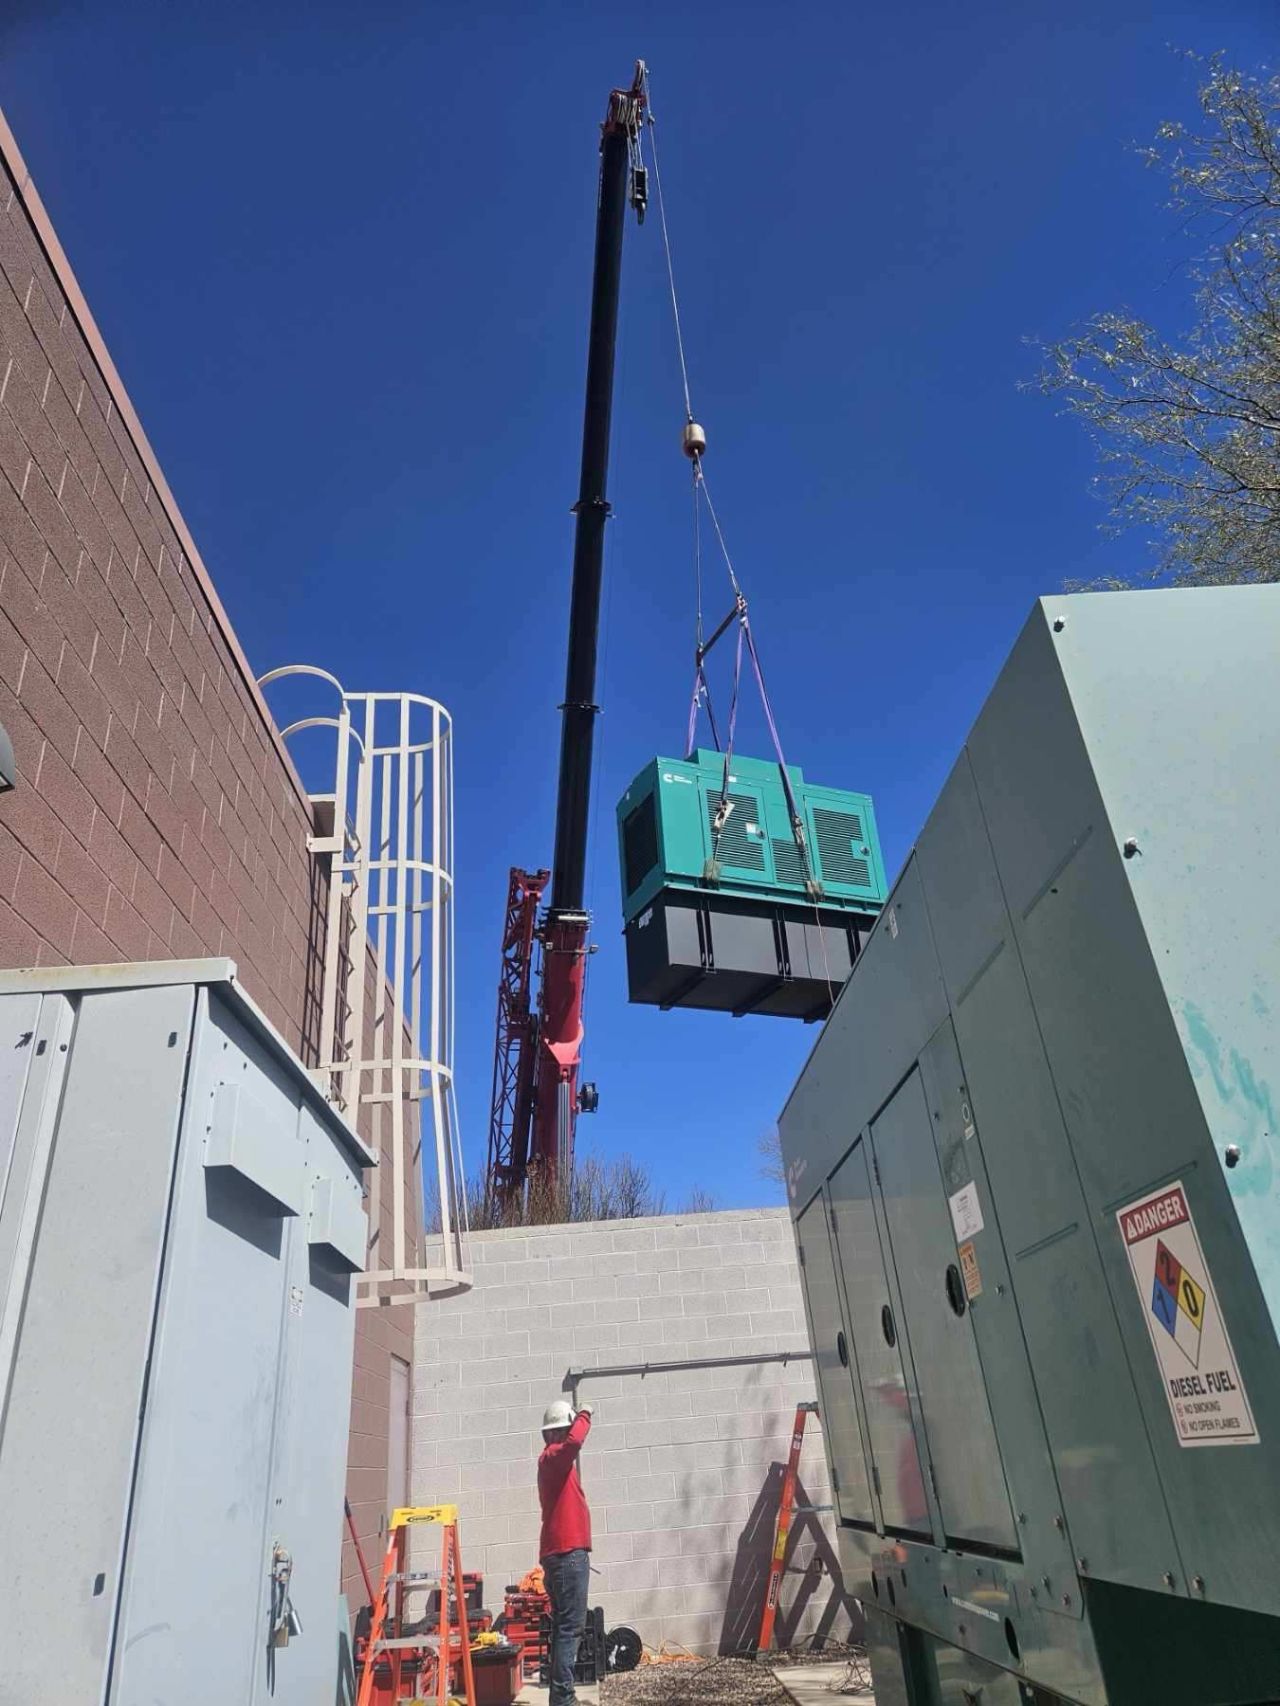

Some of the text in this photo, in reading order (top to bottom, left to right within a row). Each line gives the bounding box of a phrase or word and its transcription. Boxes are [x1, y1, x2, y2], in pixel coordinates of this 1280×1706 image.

[1134, 1196, 1184, 1235] DANGER
[1160, 1252, 1176, 1286] 2
[1158, 1290, 1172, 1324] 1
[1183, 1279, 1199, 1318] 0
[1170, 1370, 1237, 1399] DIESEL FUEL
[1184, 1400, 1221, 1414] NO SMOKING
[1189, 1417, 1240, 1431] NO OPEN FLAMES
